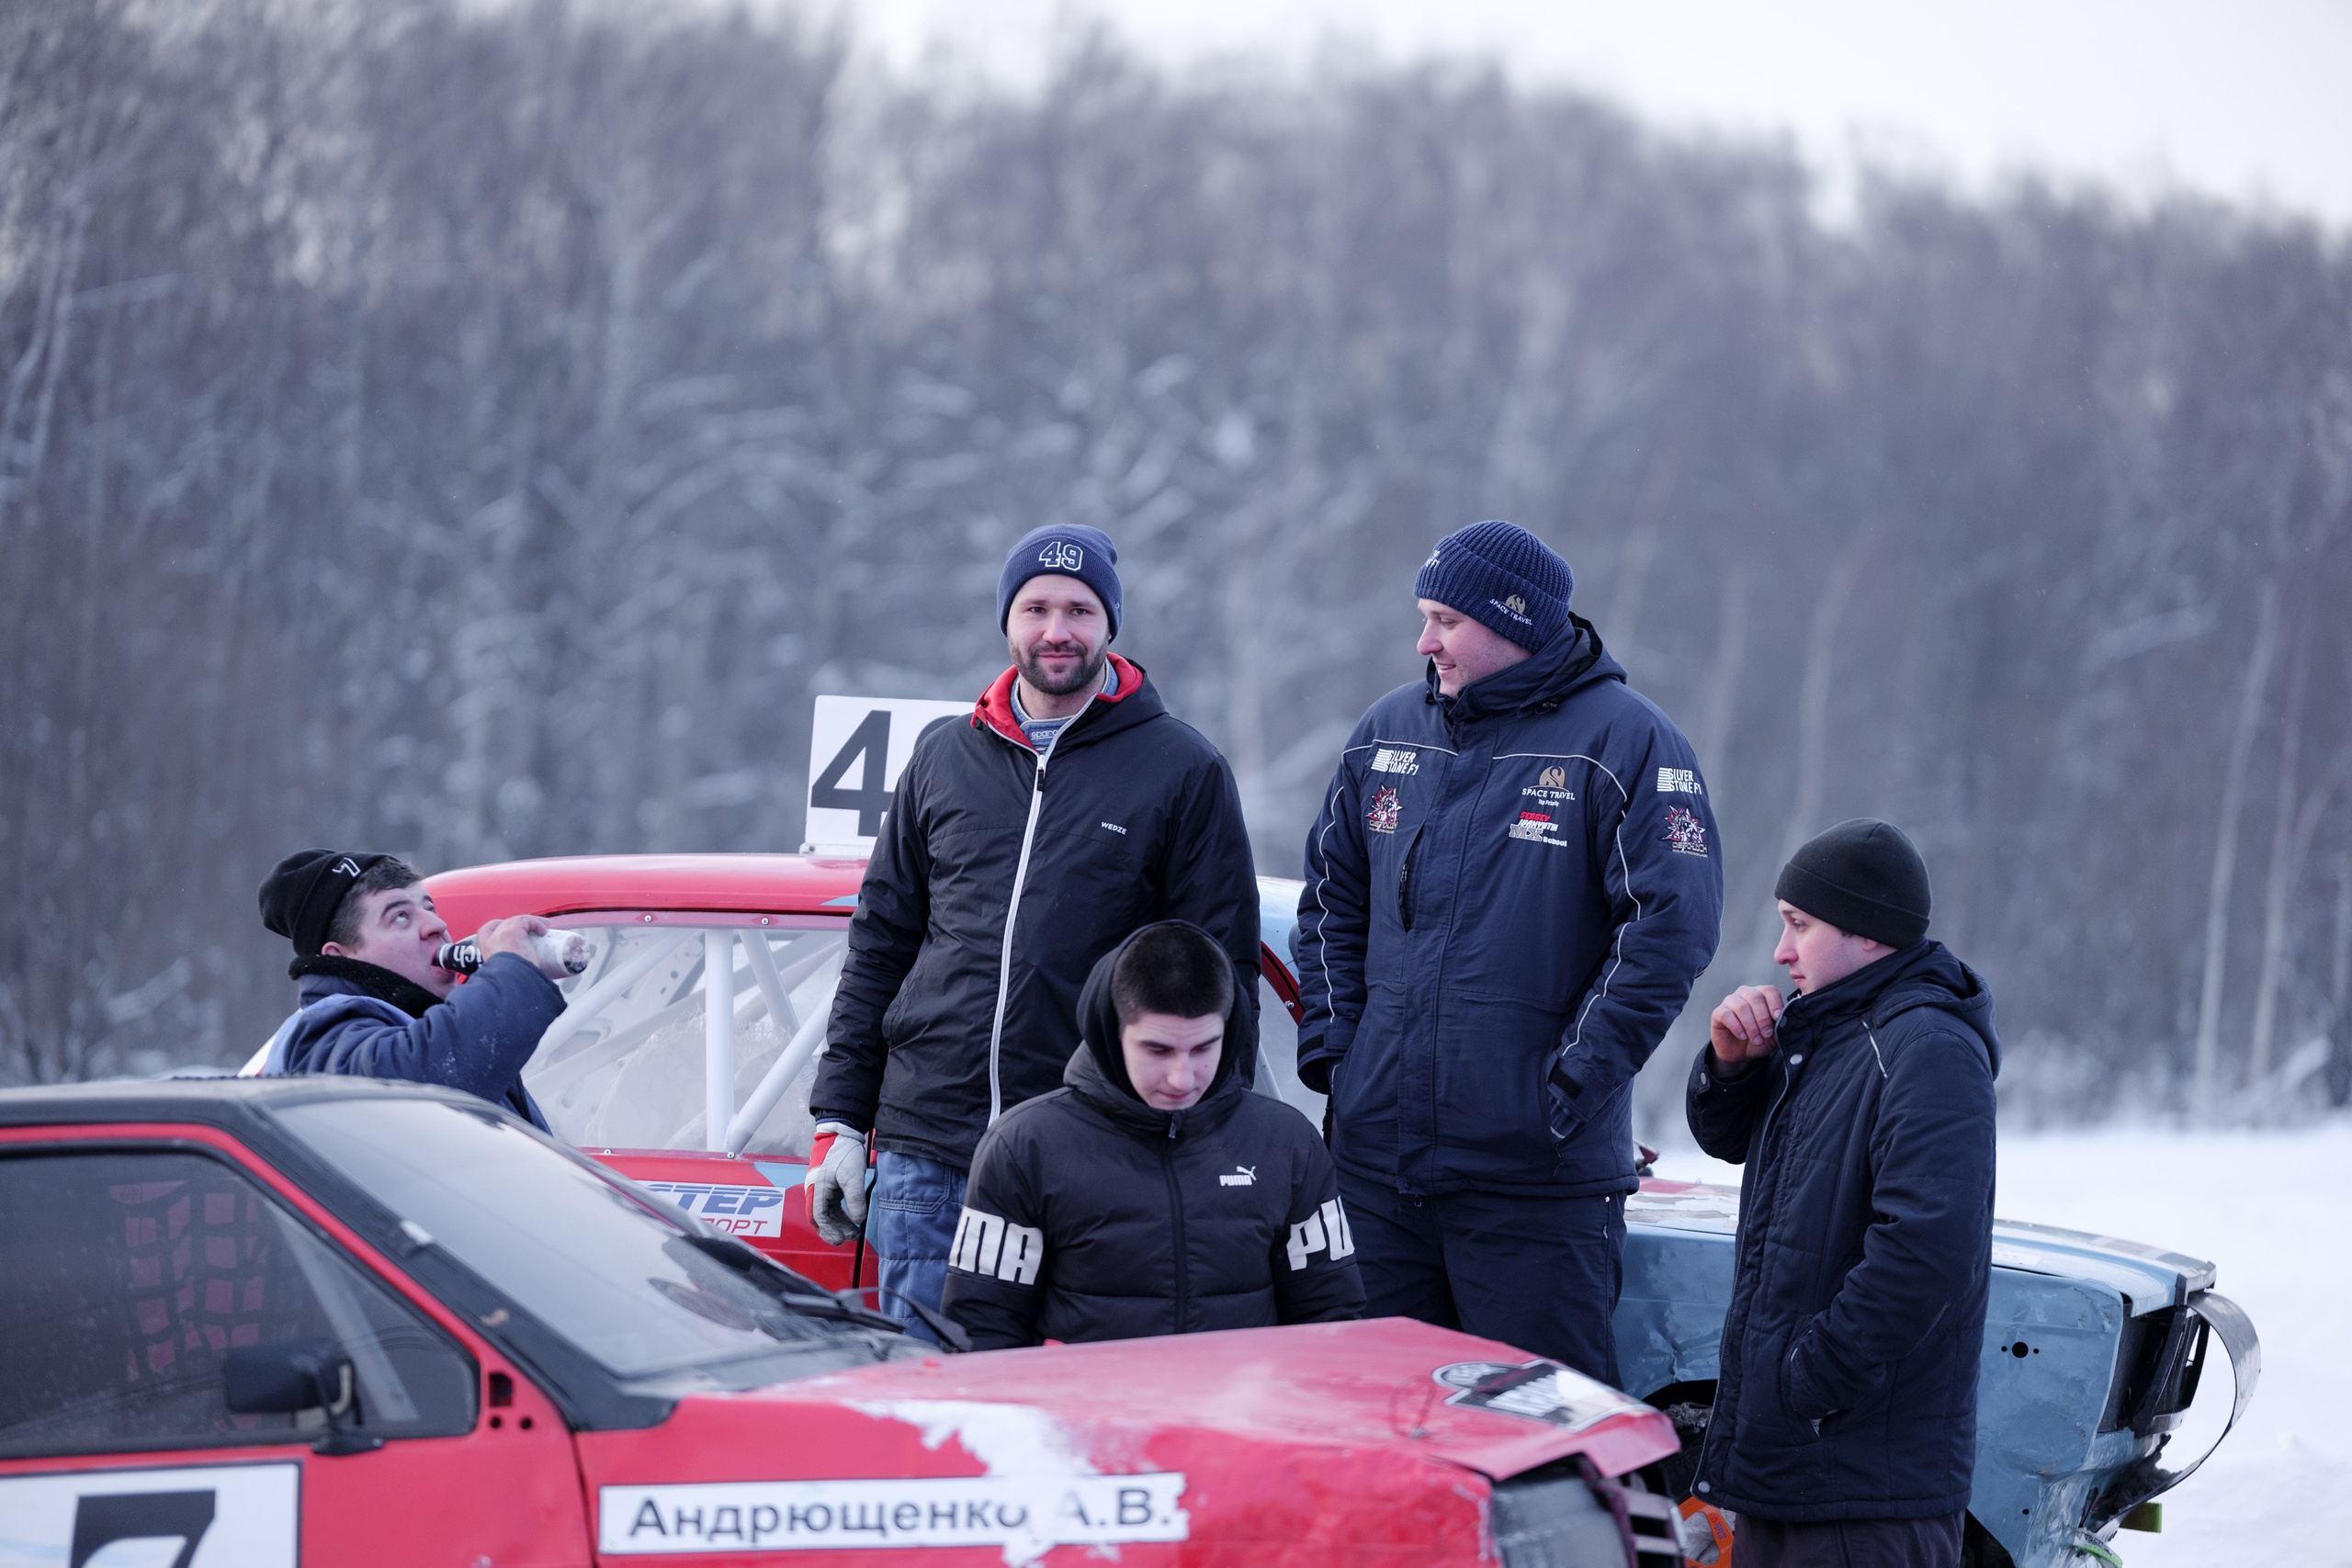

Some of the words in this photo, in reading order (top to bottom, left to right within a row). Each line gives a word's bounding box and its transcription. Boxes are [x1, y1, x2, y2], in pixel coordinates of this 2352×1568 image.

[1039, 541, 1083, 571] 49
[1489, 598, 1509, 615] SPACE
[1510, 612, 1532, 626] TRAVEL
[1388, 750, 1417, 763] SILVER
[810, 709, 961, 837] 4
[1385, 761, 1408, 774] STONE
[1406, 764, 1419, 776] F1
[1668, 768, 1694, 782] SILVER
[1521, 788, 1548, 798] SPACE
[1669, 780, 1693, 794] STONE
[1693, 784, 1702, 795] F1
[1520, 811, 1551, 822] SERGEY
[1101, 821, 1127, 835] WEDZE
[1509, 823, 1544, 841] MX
[1543, 836, 1567, 847] School
[332, 857, 360, 877] 7
[1219, 1175, 1254, 1187] PUMA
[629, 1498, 1028, 1544] Андрющенко
